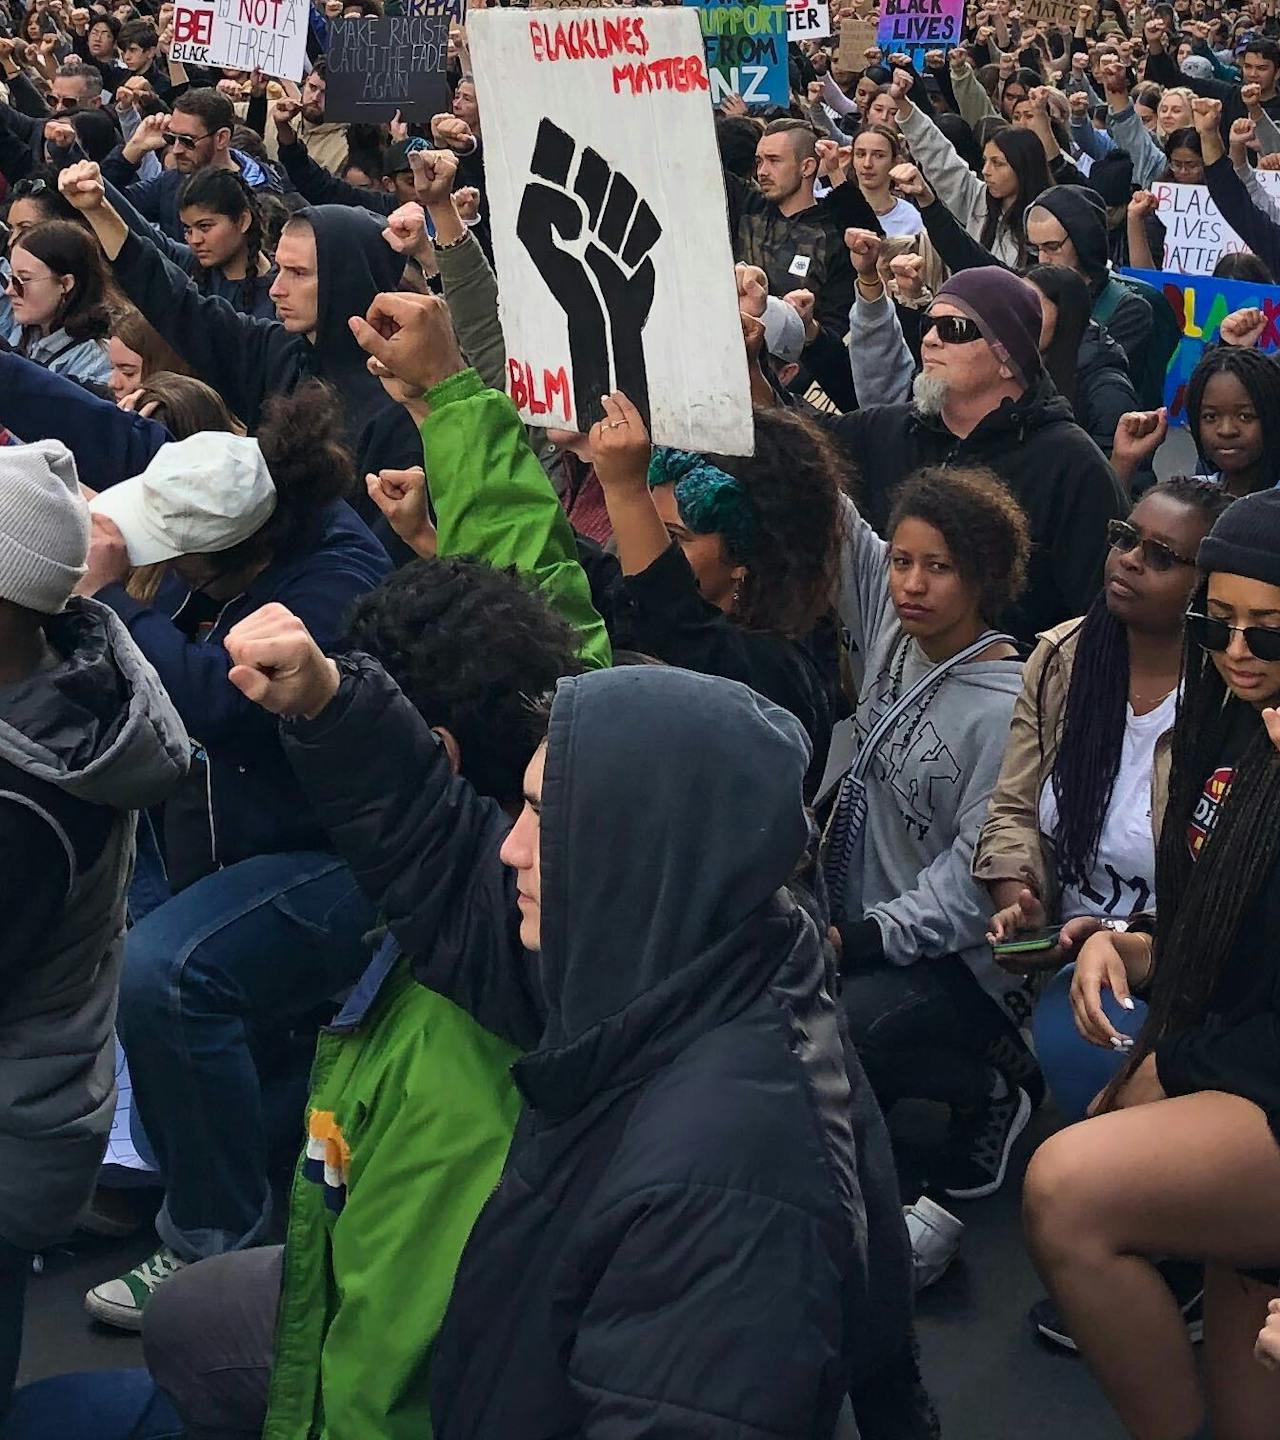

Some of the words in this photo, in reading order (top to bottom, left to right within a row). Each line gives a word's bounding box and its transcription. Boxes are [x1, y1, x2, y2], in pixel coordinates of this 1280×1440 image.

[282, 3, 297, 35] A
[699, 5, 787, 36] UPPORT
[1027, 0, 1078, 22] MATTE
[329, 18, 378, 48] MAKE
[892, 15, 954, 40] LIVES
[173, 43, 209, 63] BLACK
[327, 46, 377, 73] CATCH
[380, 46, 407, 73] THE
[411, 45, 448, 72] FADE
[704, 35, 779, 65] FROM
[363, 72, 409, 99] AGAIN
[612, 55, 710, 96] MATTER
[709, 66, 771, 103] NZ
[1157, 185, 1218, 216] BLAC
[1174, 217, 1221, 242] IVES
[507, 357, 575, 421] BLM
